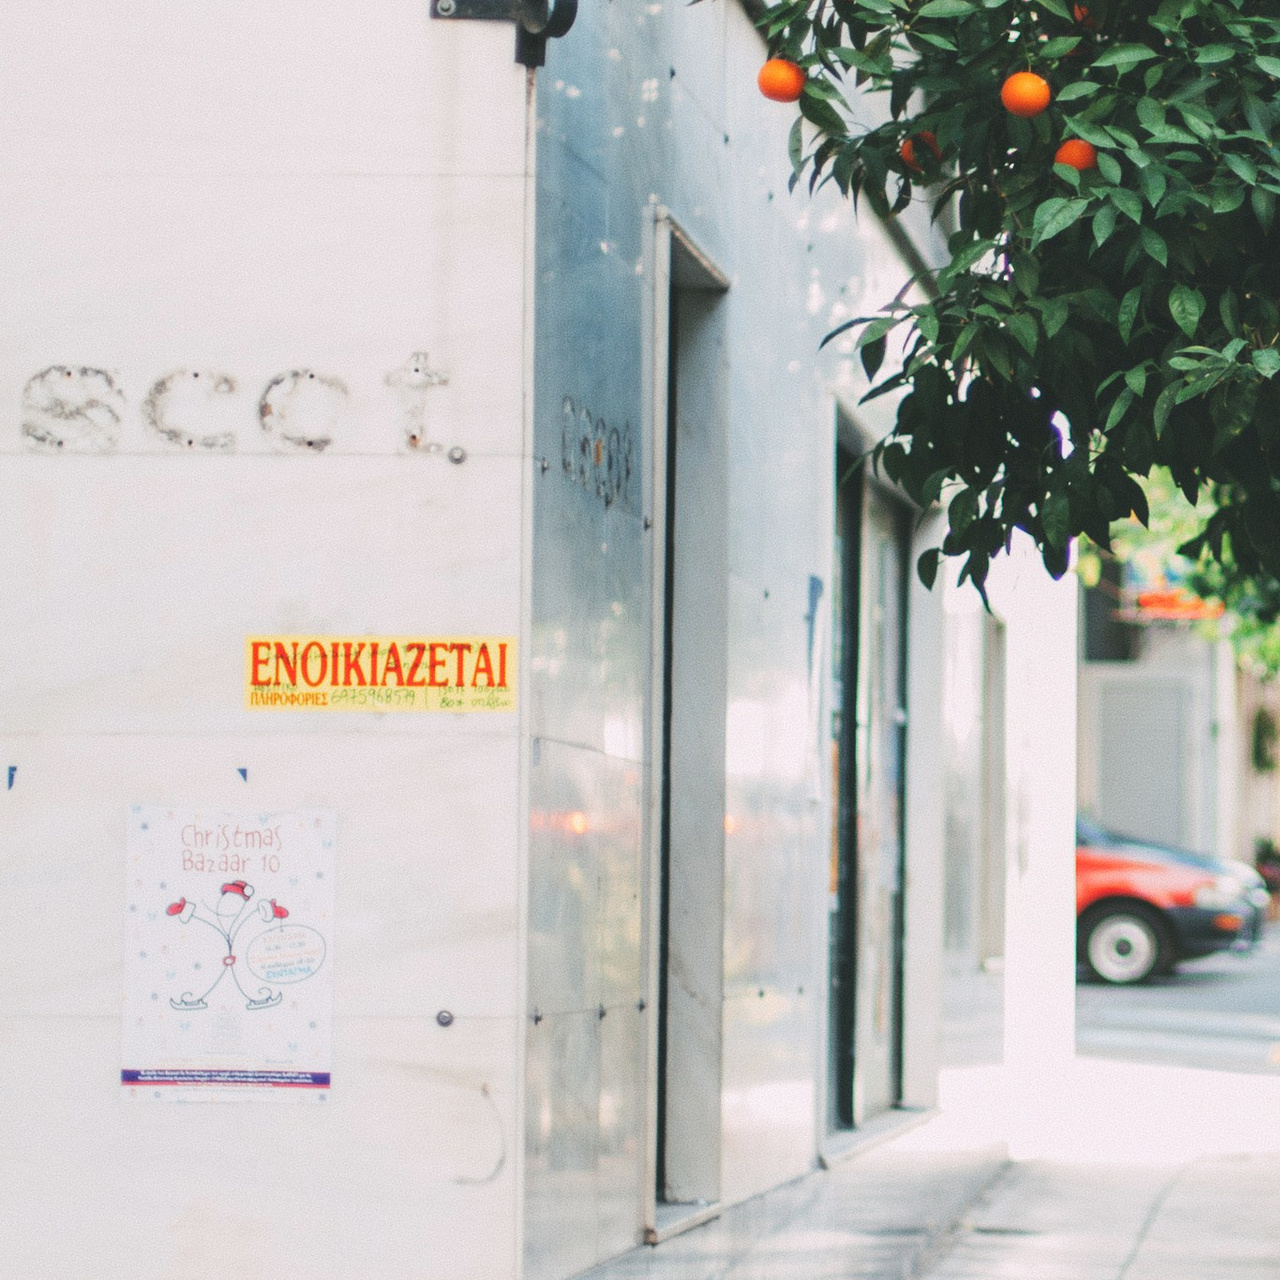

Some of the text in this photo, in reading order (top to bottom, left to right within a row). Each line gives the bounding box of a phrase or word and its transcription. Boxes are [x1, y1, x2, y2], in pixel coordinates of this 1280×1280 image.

[250, 641, 508, 688] ΕΝΟΙΚΙΑΖΕΤΑΙ
[250, 692, 328, 706] ΠΛΗΡΟΦΟΡΙΕΣ
[181, 824, 283, 851] Christmas
[182, 849, 280, 873] Bazaar 10
